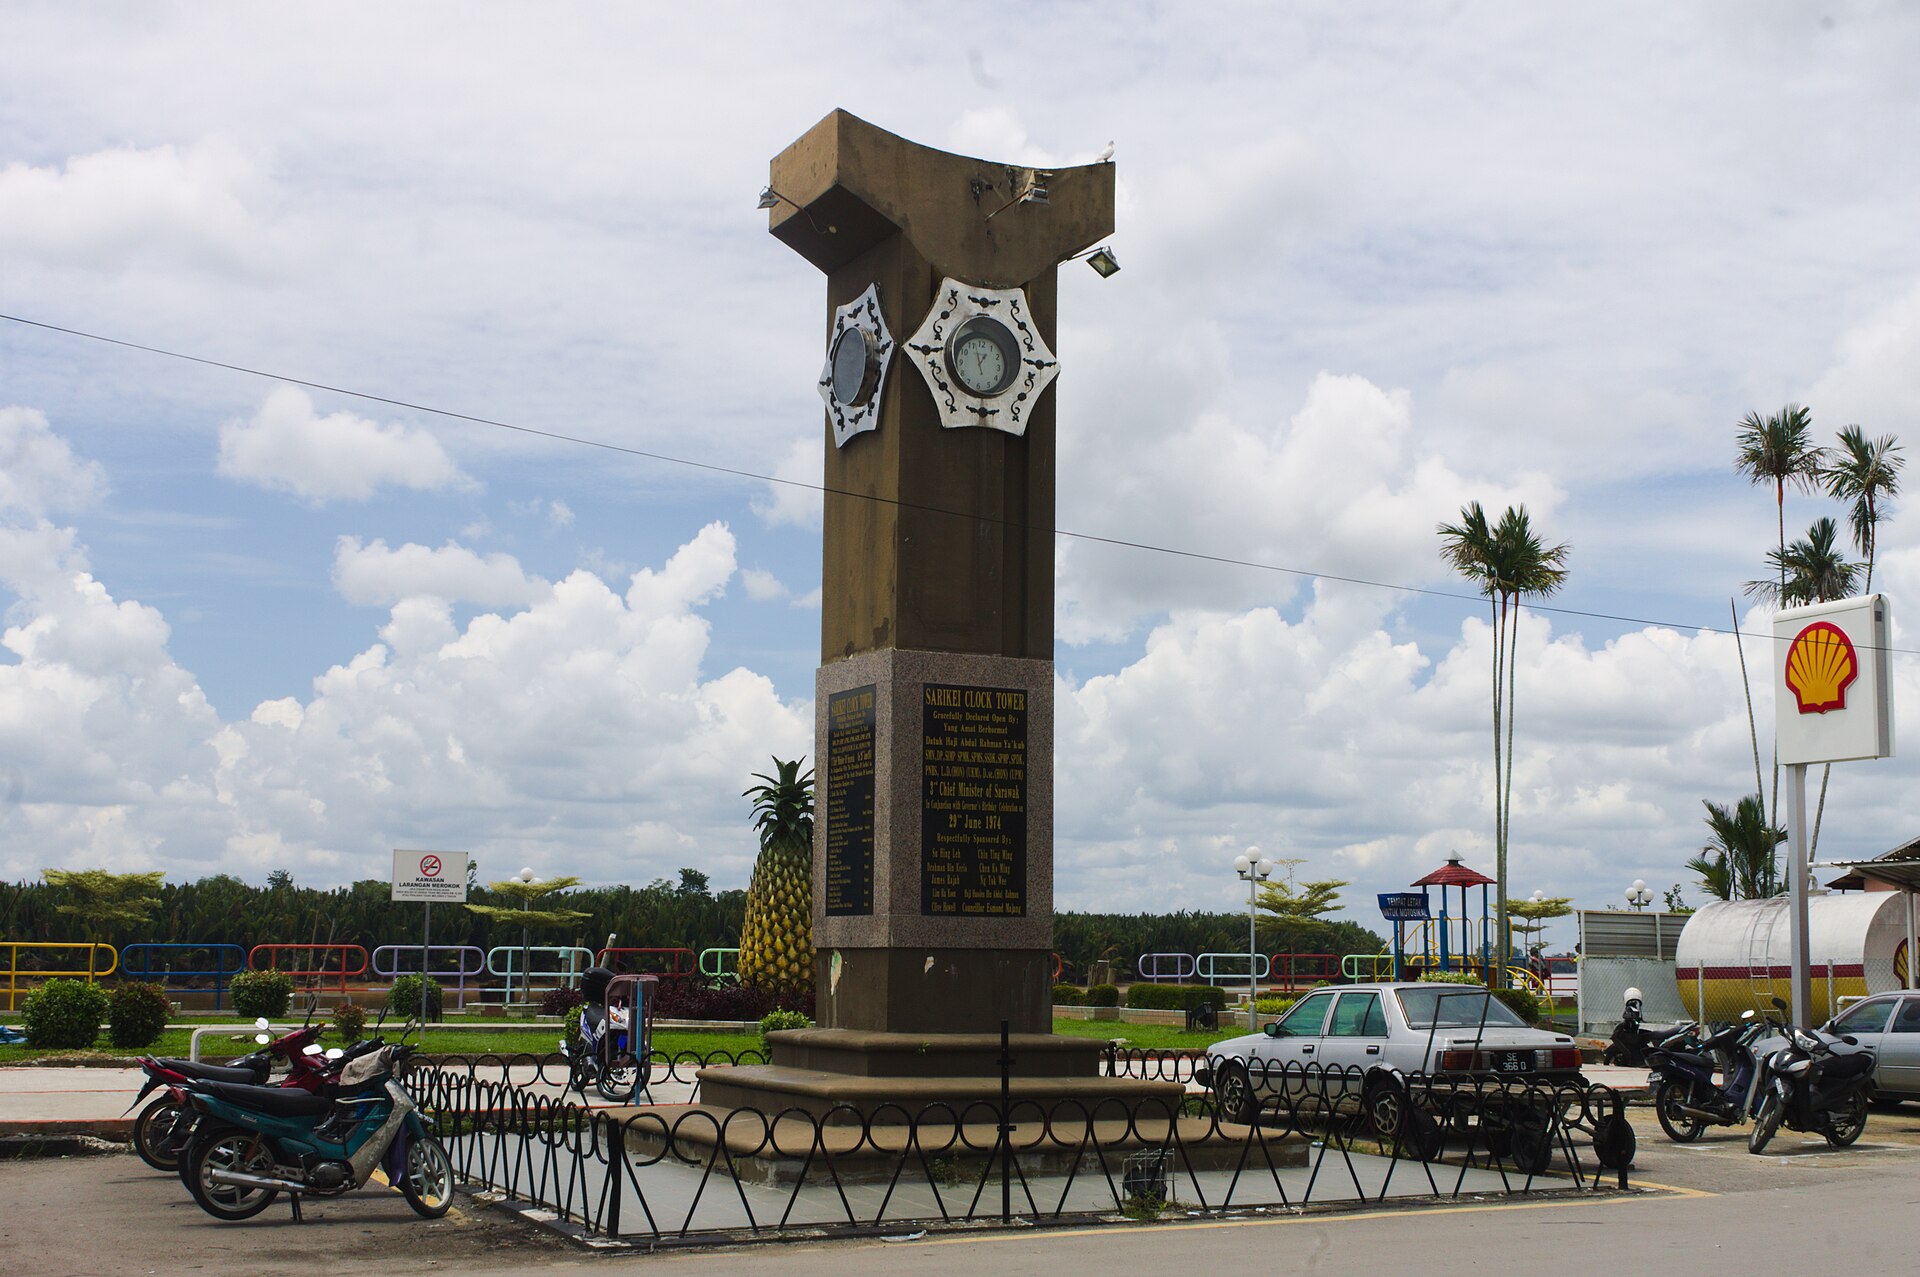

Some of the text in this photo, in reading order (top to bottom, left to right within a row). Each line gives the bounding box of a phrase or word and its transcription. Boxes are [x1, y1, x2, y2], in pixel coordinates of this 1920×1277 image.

[926, 688, 1024, 711] SARIKEI CLOCK TOWER
[933, 711, 963, 721] Gracefully
[966, 712, 989, 721] Declared
[992, 714, 1005, 723] Open
[944, 723, 1008, 734] Yang Amat Berhormat
[926, 736, 943, 745] Datuk
[946, 737, 957, 747] Haji
[961, 738, 977, 747] Abdul
[980, 739, 1002, 748] Rahman
[939, 781, 955, 796] Chief
[959, 782, 983, 797] Minister
[986, 784, 992, 797] of
[995, 784, 1020, 799] Sarawak
[964, 815, 981, 829] June
[986, 816, 1001, 830] 1974
[937, 833, 970, 844] Respectfully
[973, 834, 999, 845] Sponsored
[1506, 1053, 1517, 1061] SE
[1503, 1062, 1518, 1070] 366
